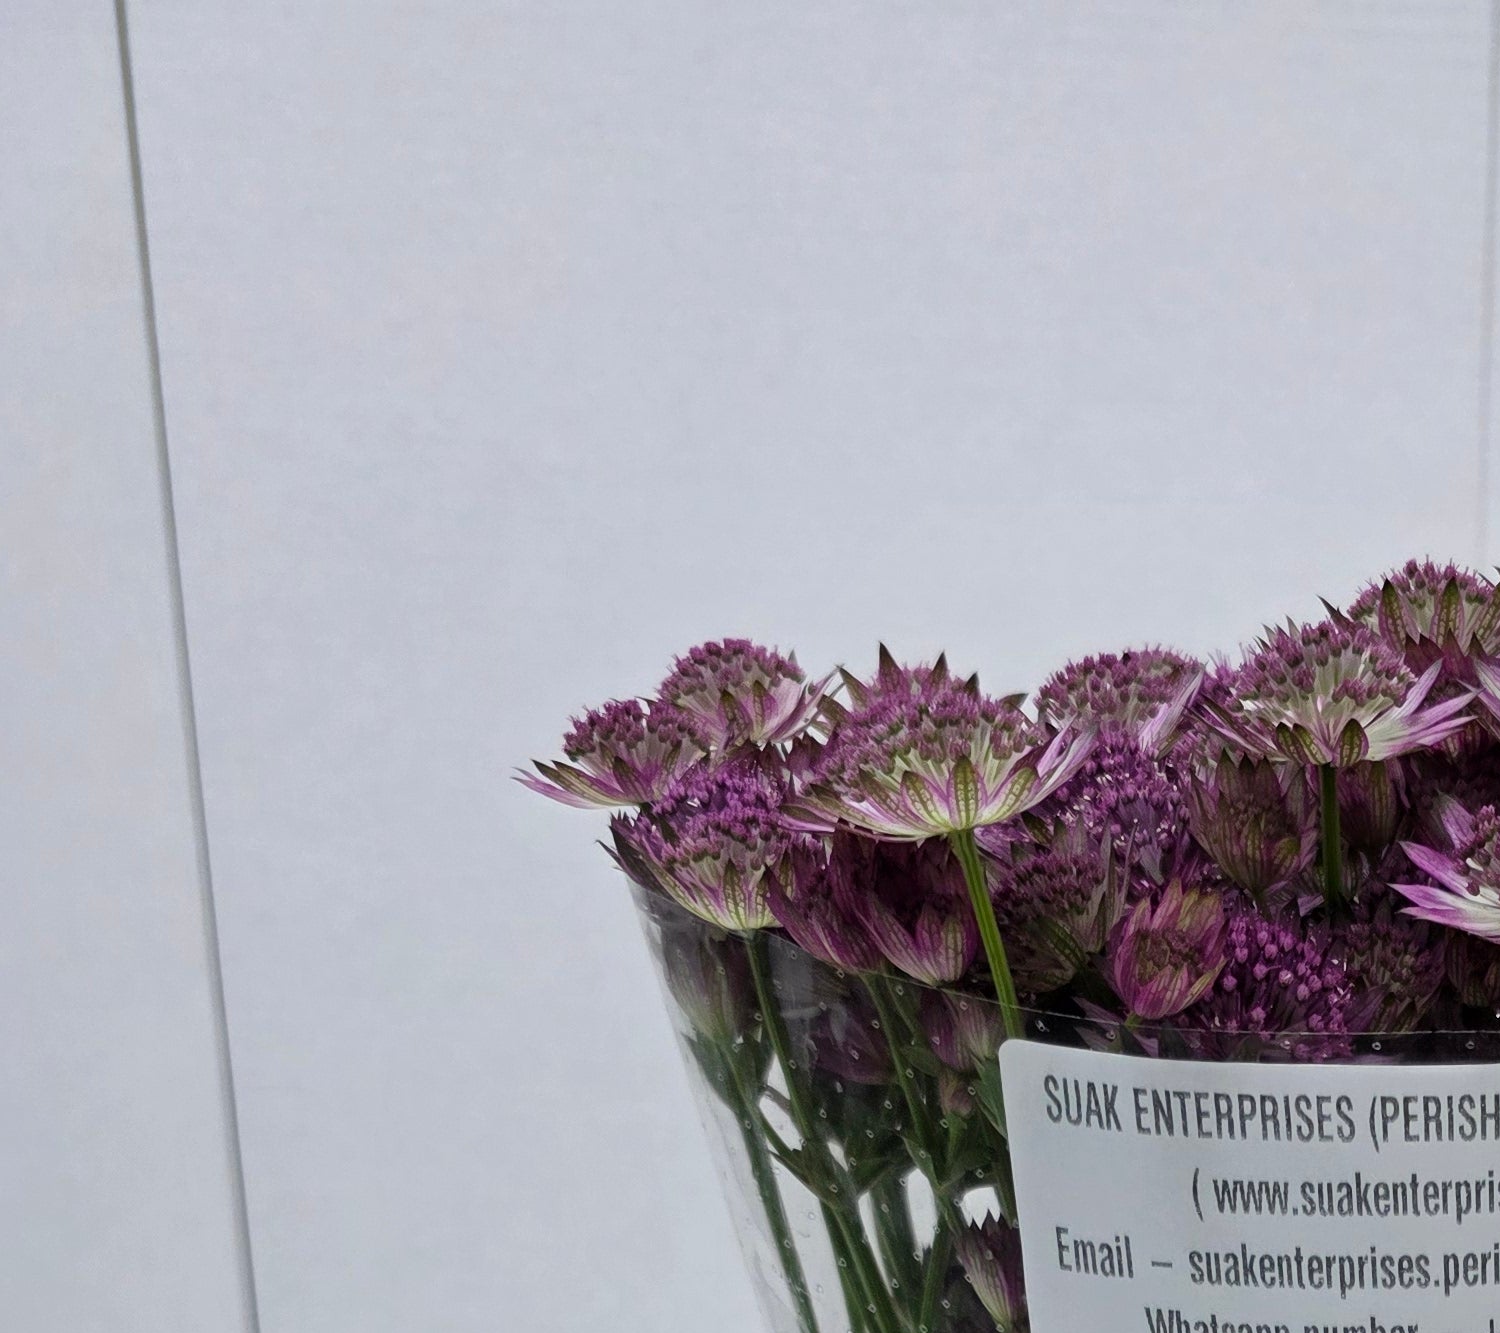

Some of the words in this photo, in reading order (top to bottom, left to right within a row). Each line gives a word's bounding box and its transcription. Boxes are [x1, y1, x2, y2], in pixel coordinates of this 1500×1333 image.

[1044, 1075, 1122, 1131] SUAK
[1133, 1088, 1355, 1142] ENTERPRISES
[1193, 1168, 1203, 1221] (
[1056, 1226, 1133, 1278] Email
